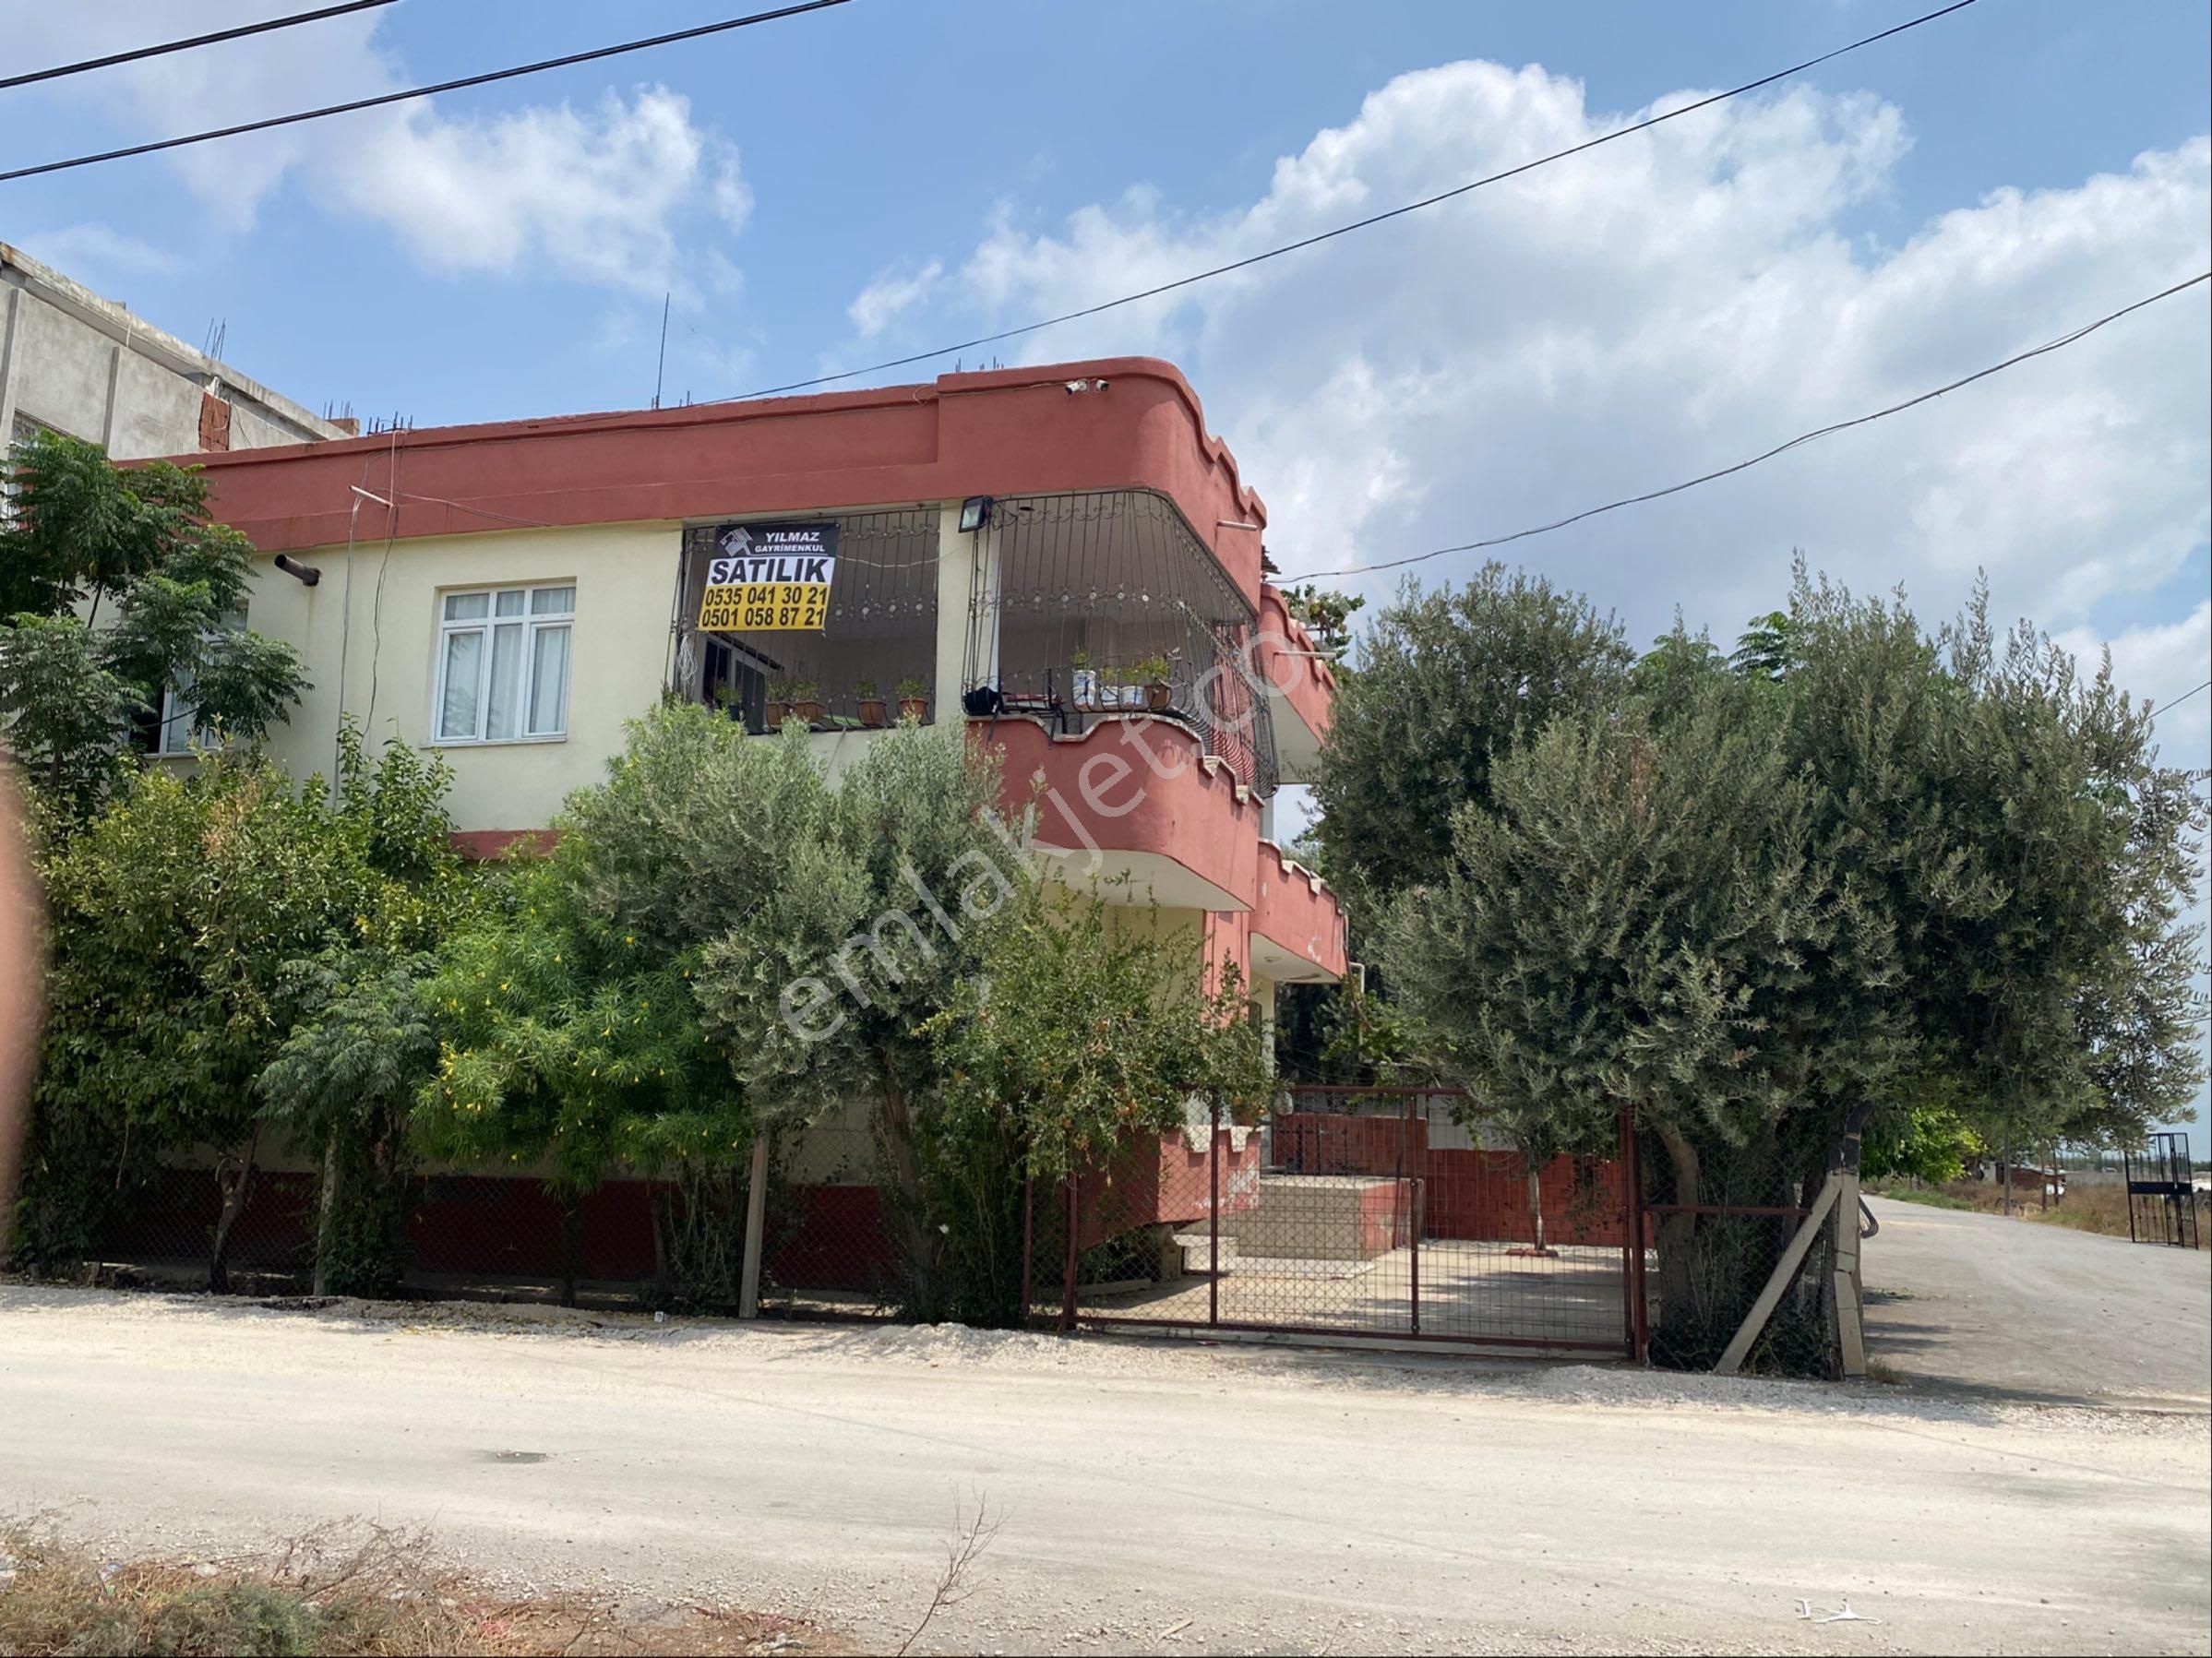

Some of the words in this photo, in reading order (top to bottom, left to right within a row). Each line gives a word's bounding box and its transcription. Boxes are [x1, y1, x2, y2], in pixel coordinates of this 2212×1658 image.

[765, 531, 820, 543] YILMAZ
[754, 543, 826, 553] GAYRİMENKUL
[711, 558, 829, 585] SATILIK
[705, 587, 743, 606] 0535
[747, 586, 776, 605] 041
[782, 586, 802, 604] 30
[807, 587, 828, 605] 21
[701, 607, 738, 626] 0501
[745, 607, 774, 626] 058
[779, 607, 800, 626] 87
[804, 607, 824, 626] 21
